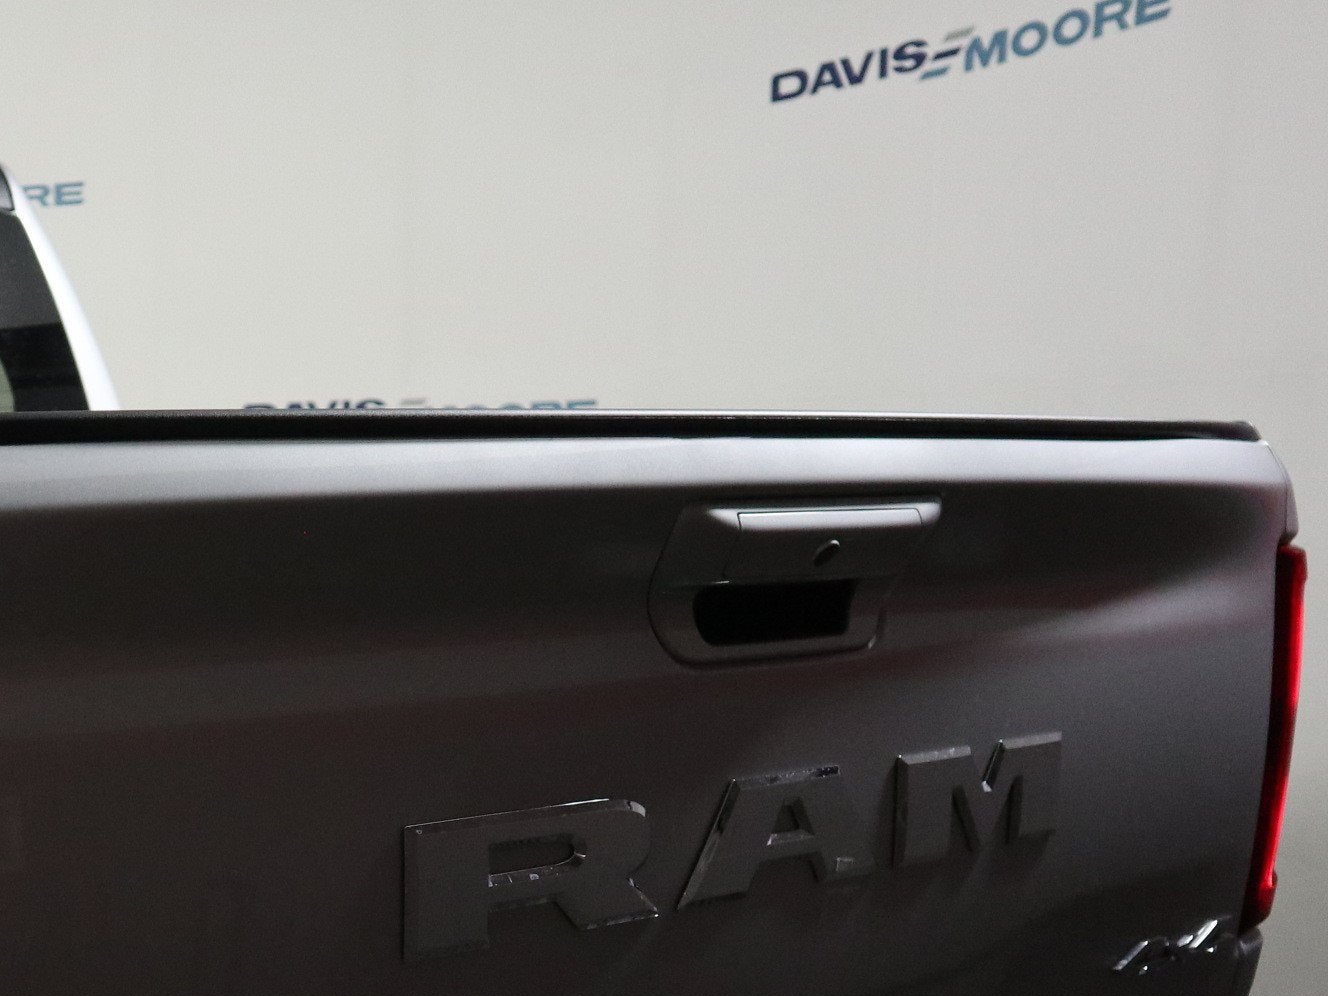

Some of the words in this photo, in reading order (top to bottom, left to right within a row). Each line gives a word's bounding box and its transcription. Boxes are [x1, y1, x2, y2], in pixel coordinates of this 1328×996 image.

[771, 39, 928, 102] DAVIS
[964, 0, 1171, 72] MOORE
[403, 731, 1063, 959] RAM
